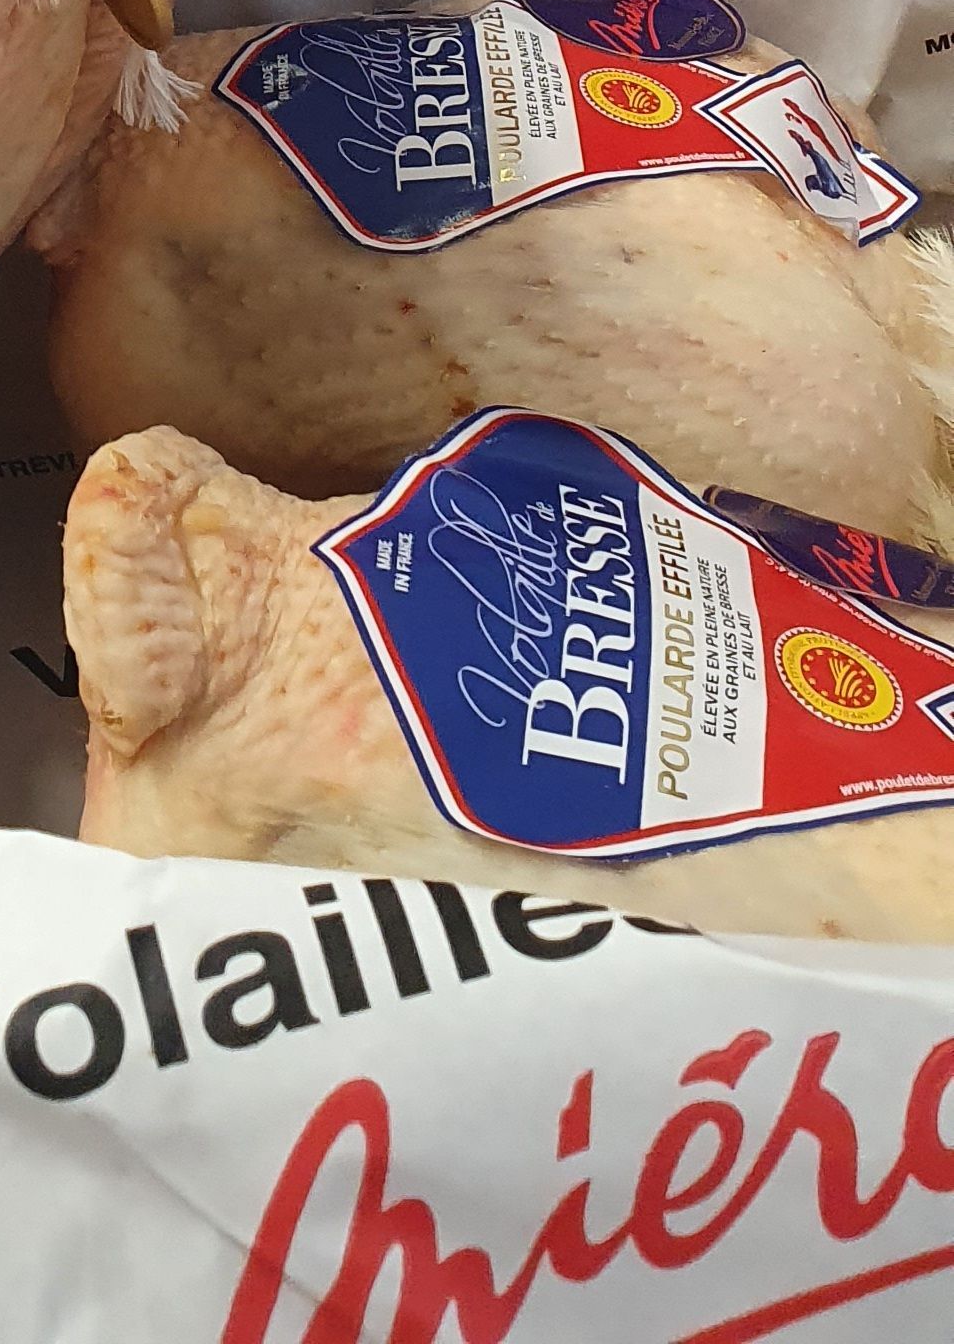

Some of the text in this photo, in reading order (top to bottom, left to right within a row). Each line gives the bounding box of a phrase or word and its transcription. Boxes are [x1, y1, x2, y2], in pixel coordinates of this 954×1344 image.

[525, 88, 537, 103] EN
[537, 63, 548, 78] DE
[551, 79, 564, 94] AU
[554, 93, 567, 107] ET
[396, 22, 478, 193] BRESSE
[545, 117, 558, 140] AUX
[376, 537, 395, 571] MADE
[394, 531, 415, 594] IN FRANCE
[426, 467, 574, 728] Volaille
[521, 484, 636, 786] BRESSE
[646, 513, 696, 801] POULARDE EFFILÉE
[696, 558, 719, 738] ÉLEVÉE EN PLEINE NATURE
[717, 563, 739, 745] AUX GRAINES DE BRESSE
[738, 612, 757, 681] ET AU LAIT
